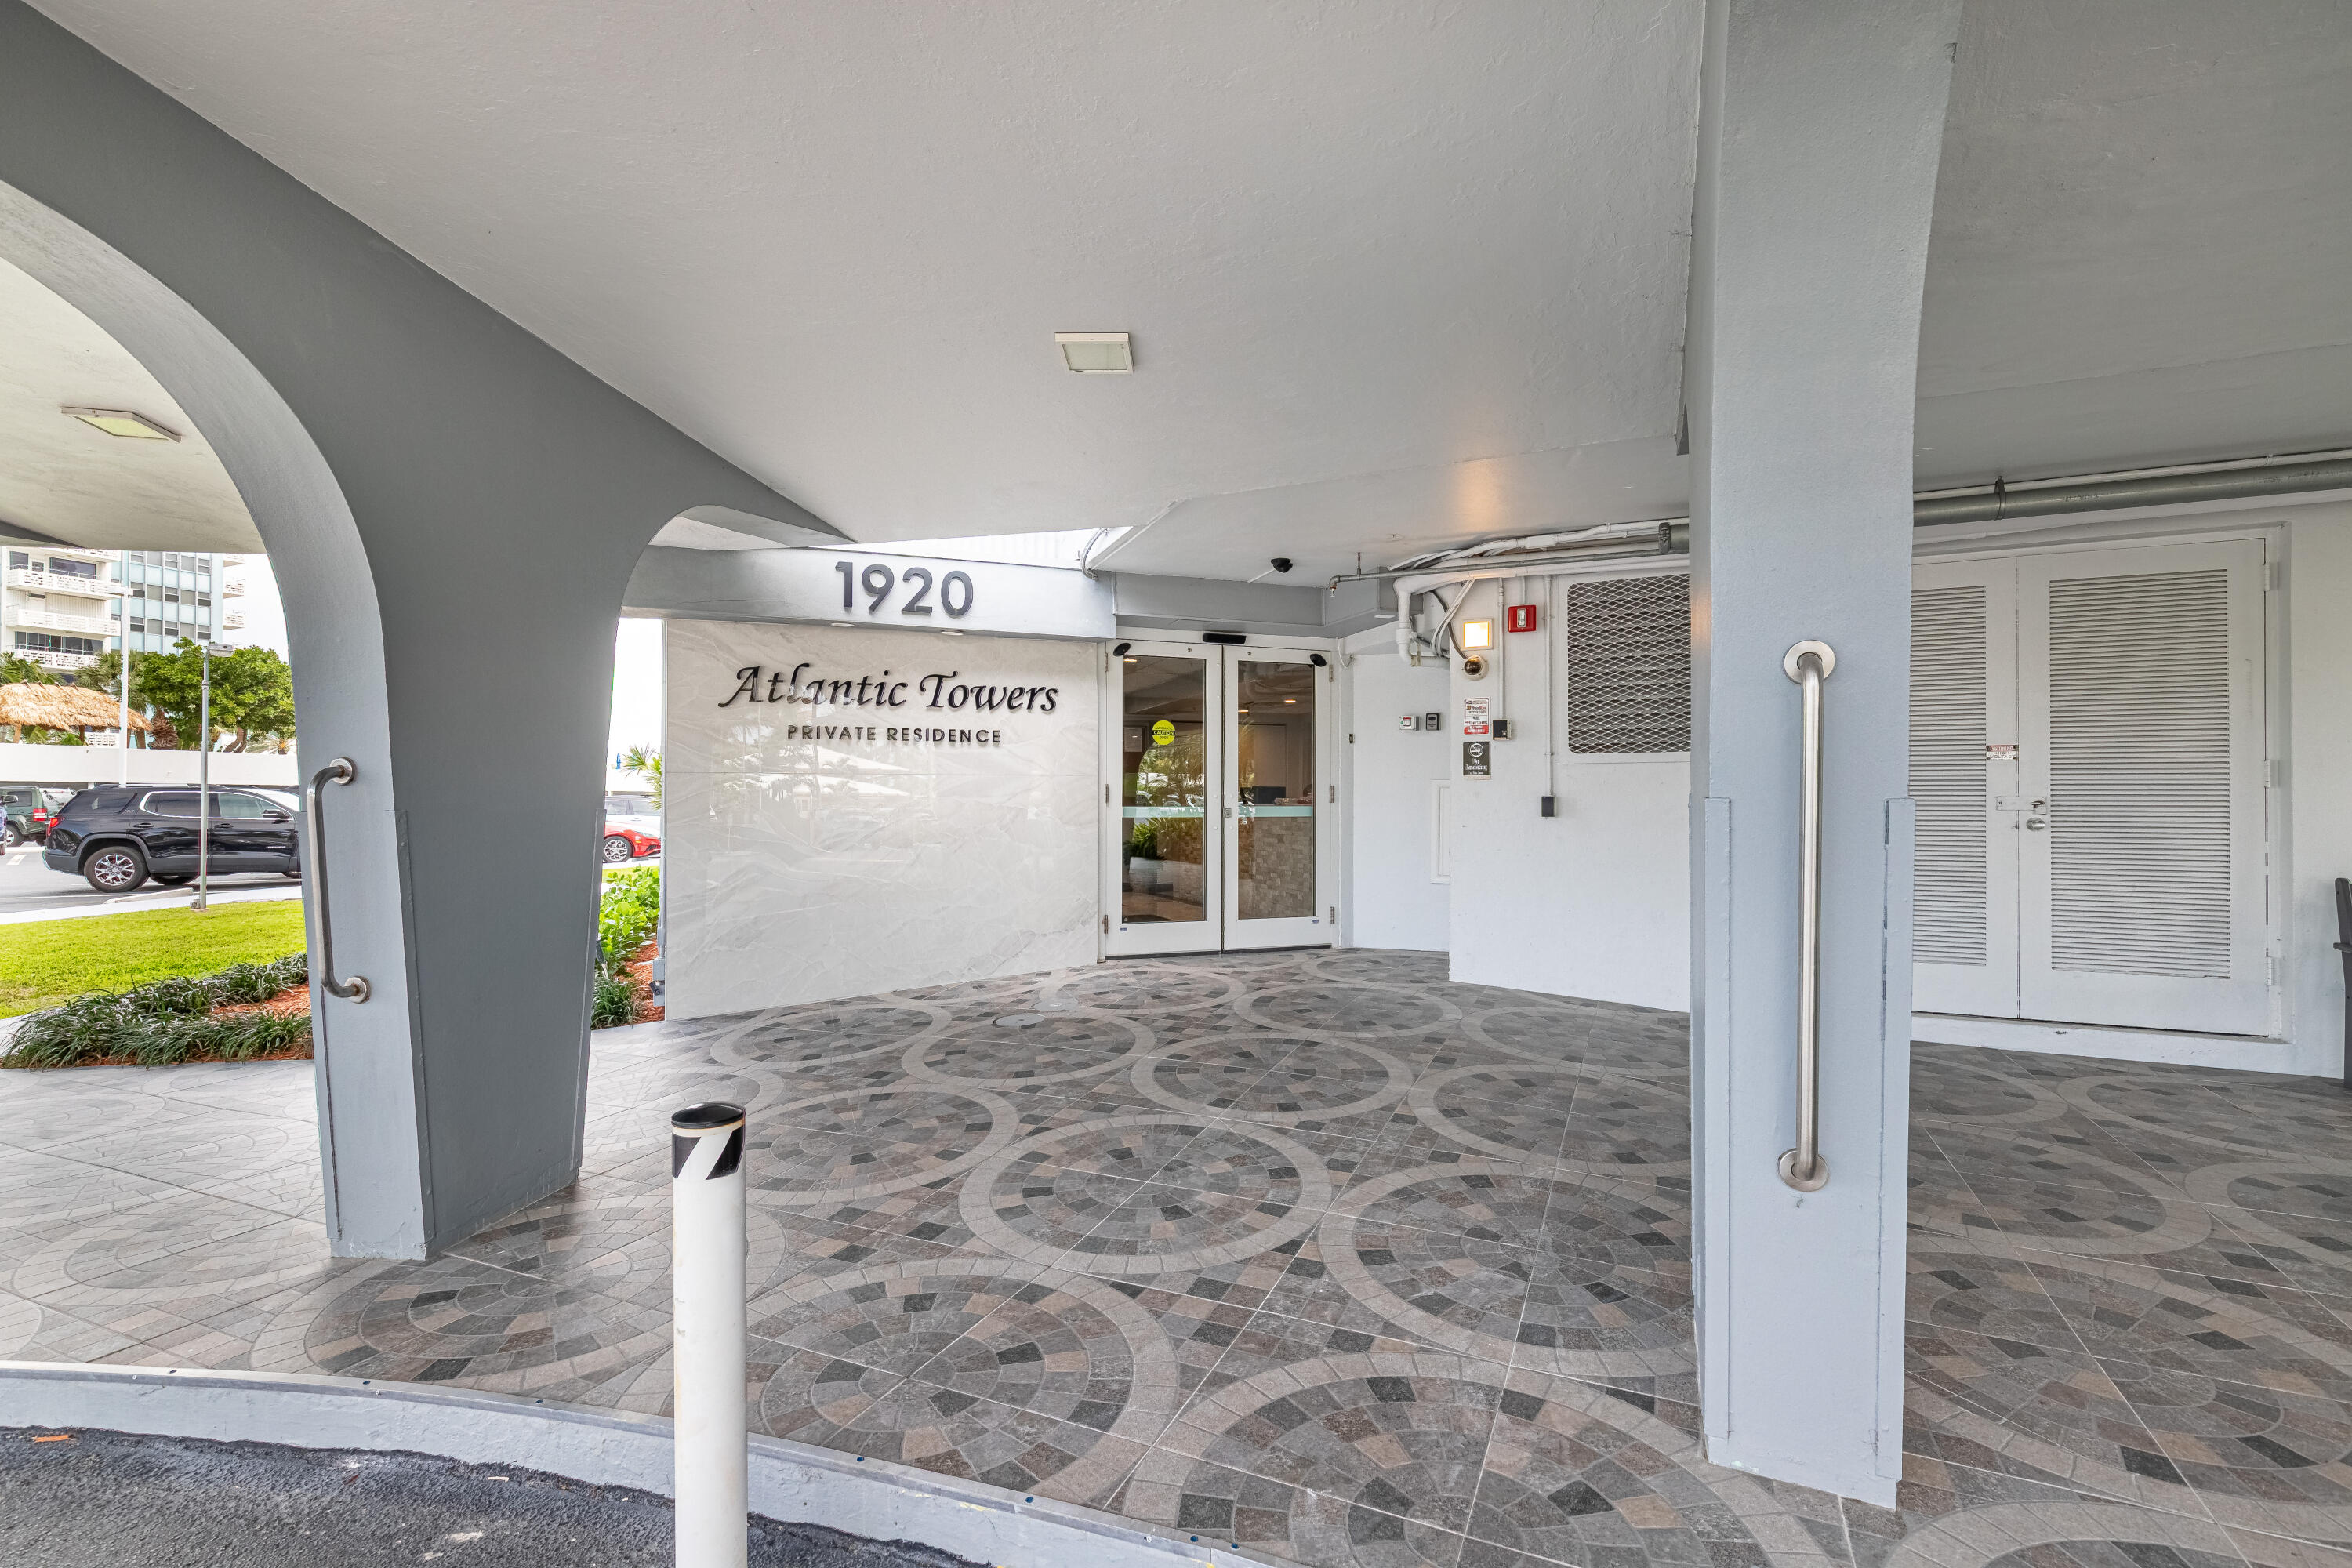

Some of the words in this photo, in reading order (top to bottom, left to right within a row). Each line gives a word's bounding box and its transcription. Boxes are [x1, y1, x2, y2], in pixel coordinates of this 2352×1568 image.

[835, 561, 974, 616] 1920
[717, 662, 909, 707] Atlantic
[920, 670, 1059, 712] Towers
[787, 724, 877, 741] PRIVATE
[887, 727, 1001, 744] RESIDENCE
